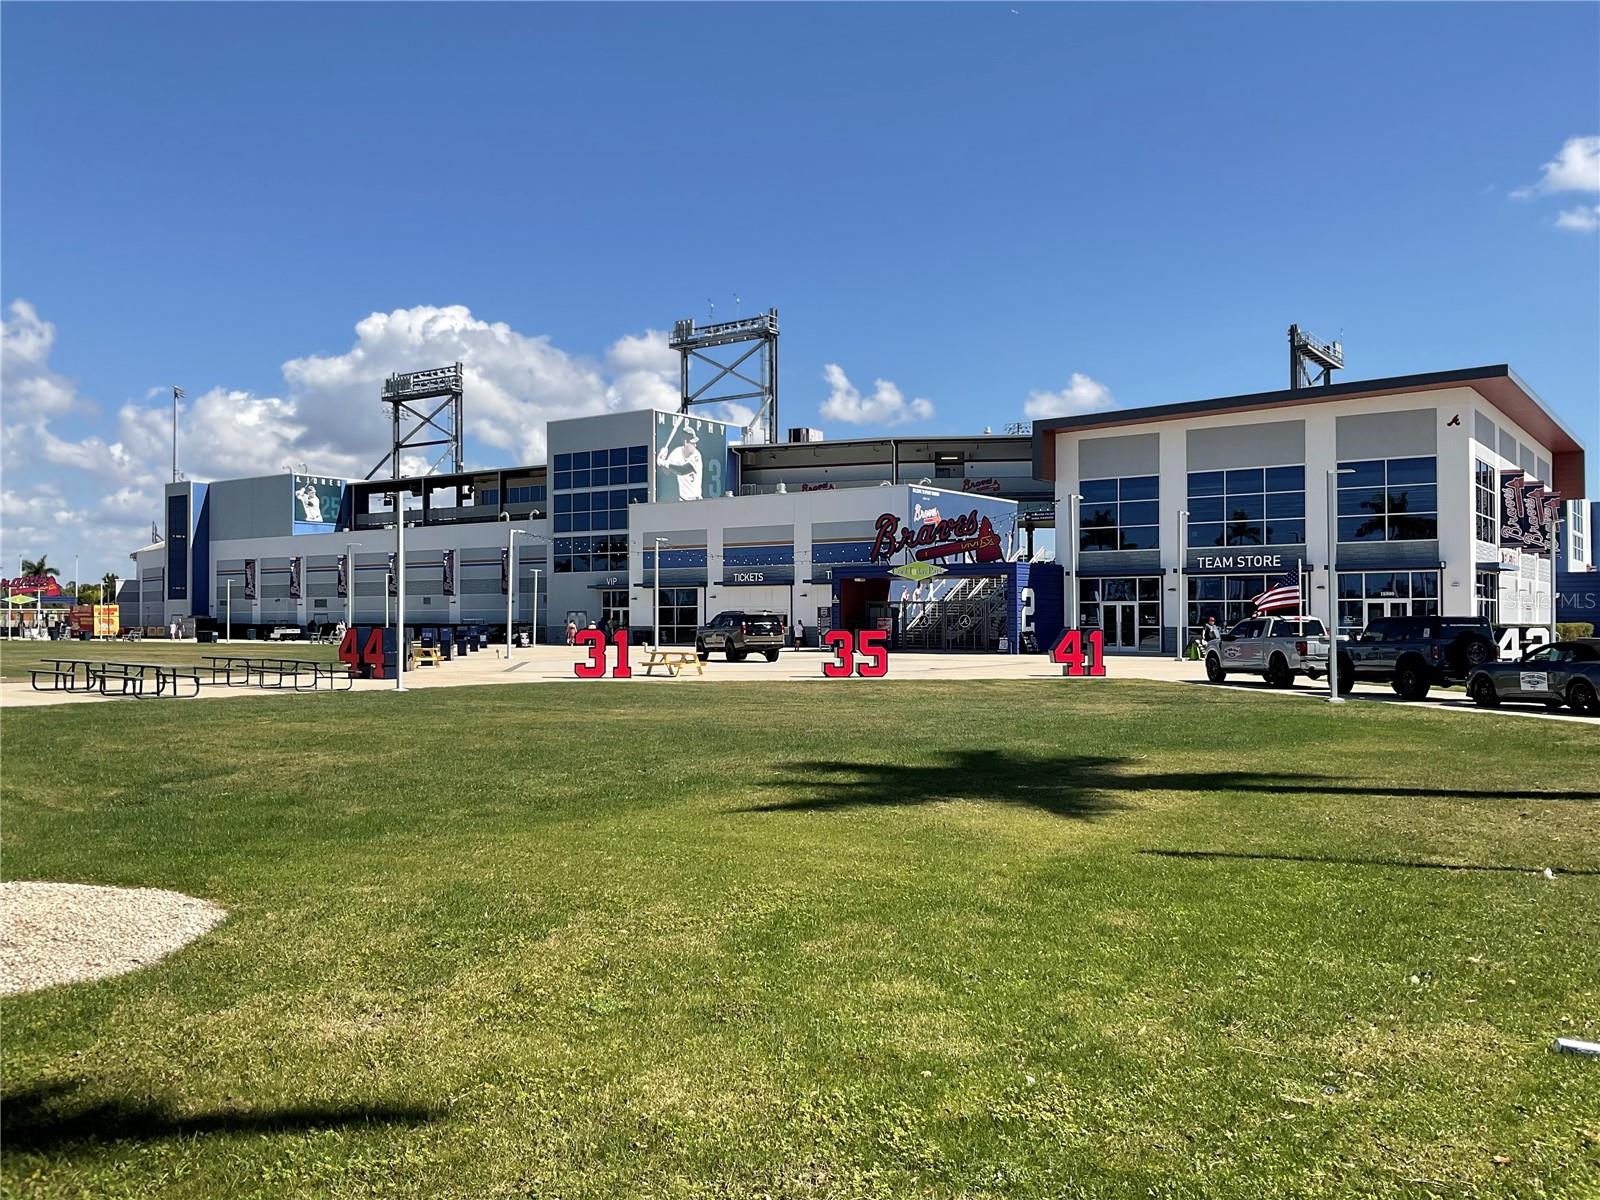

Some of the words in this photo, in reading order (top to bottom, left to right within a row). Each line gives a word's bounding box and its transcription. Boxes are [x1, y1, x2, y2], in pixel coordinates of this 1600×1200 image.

[658, 412, 726, 437] MURPHY
[708, 458, 722, 499] 3
[869, 509, 980, 564] Braves
[606, 577, 618, 585] VIP
[733, 572, 764, 582] TICKETS
[1197, 556, 1233, 568] TEAM
[1237, 555, 1281, 567] STORE
[1021, 587, 1035, 633] 2
[338, 627, 385, 679] 44
[574, 627, 632, 679] 31
[823, 629, 888, 678] 35
[1053, 629, 1106, 677] 41
[1497, 627, 1550, 662] 42
